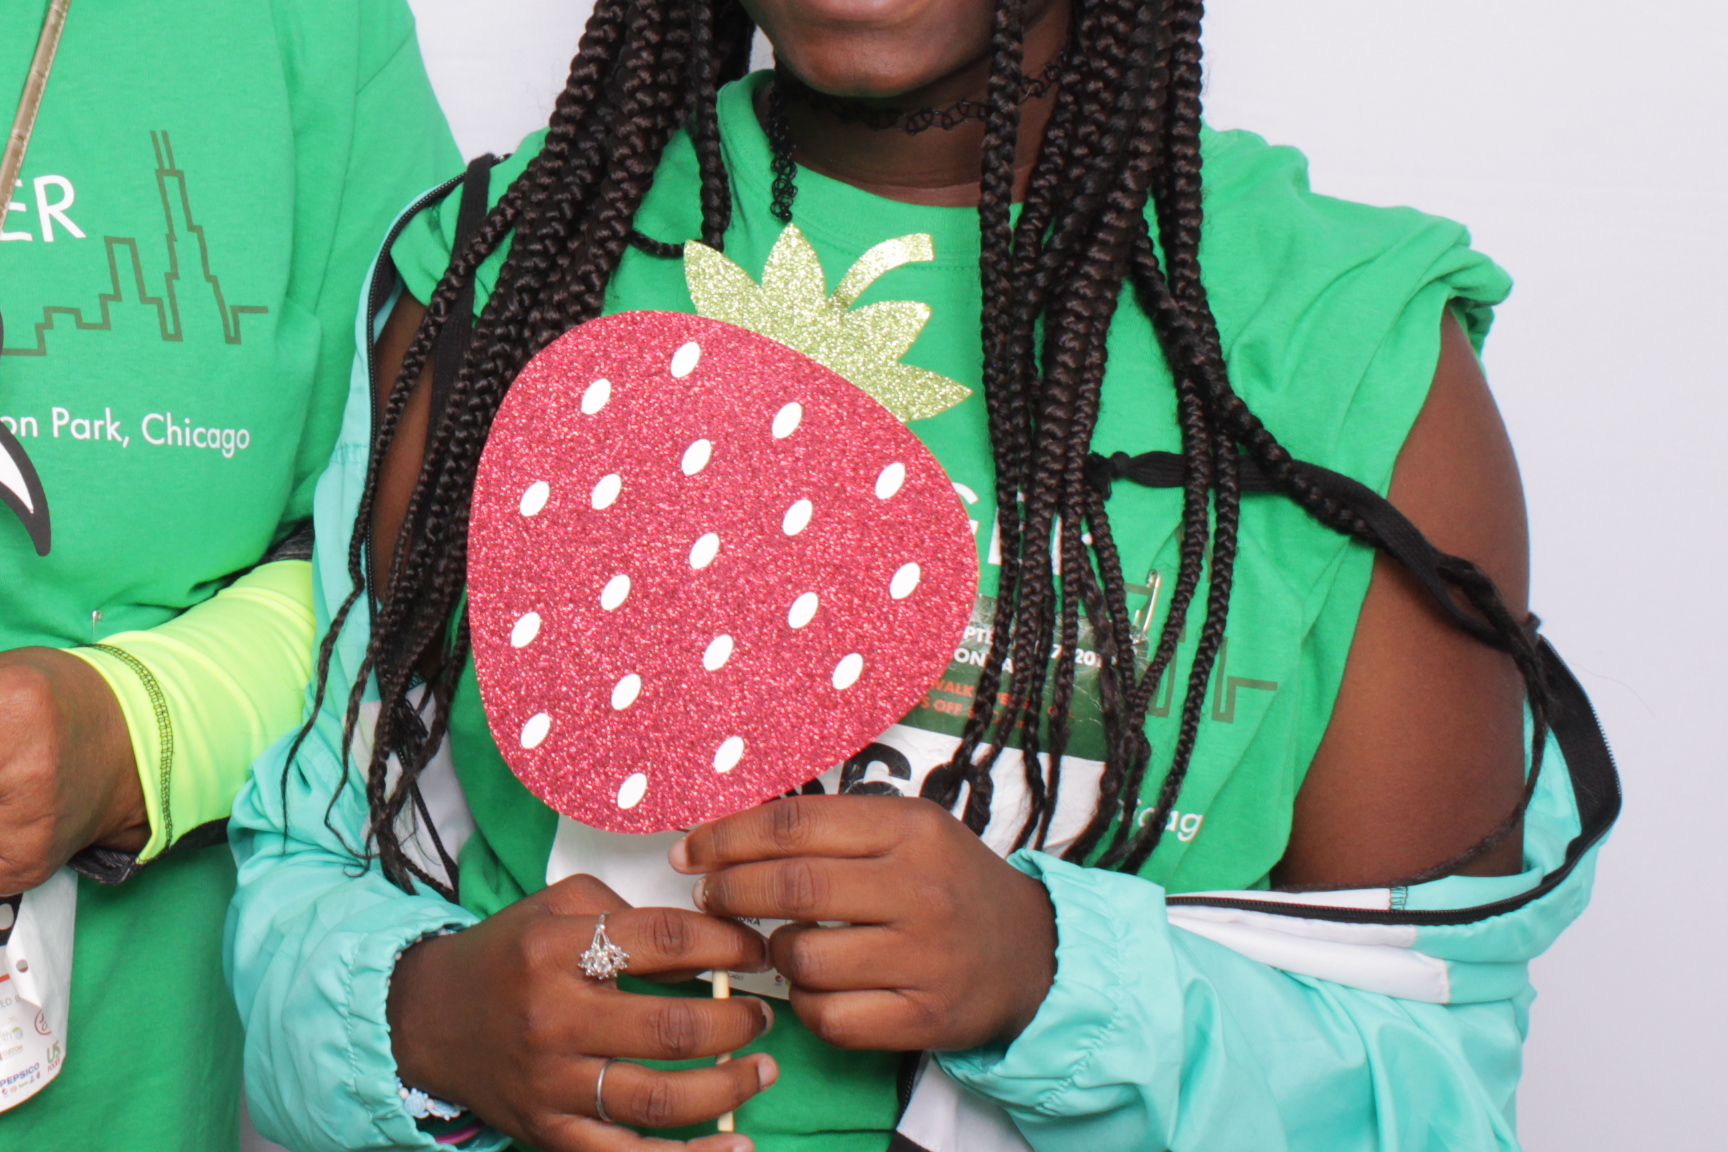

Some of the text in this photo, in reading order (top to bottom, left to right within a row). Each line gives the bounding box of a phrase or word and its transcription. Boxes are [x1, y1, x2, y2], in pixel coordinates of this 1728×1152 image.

[51, 406, 130, 449] Park,
[141, 411, 251, 458] Chicago
[0, 1062, 40, 1087] PEPSICO
